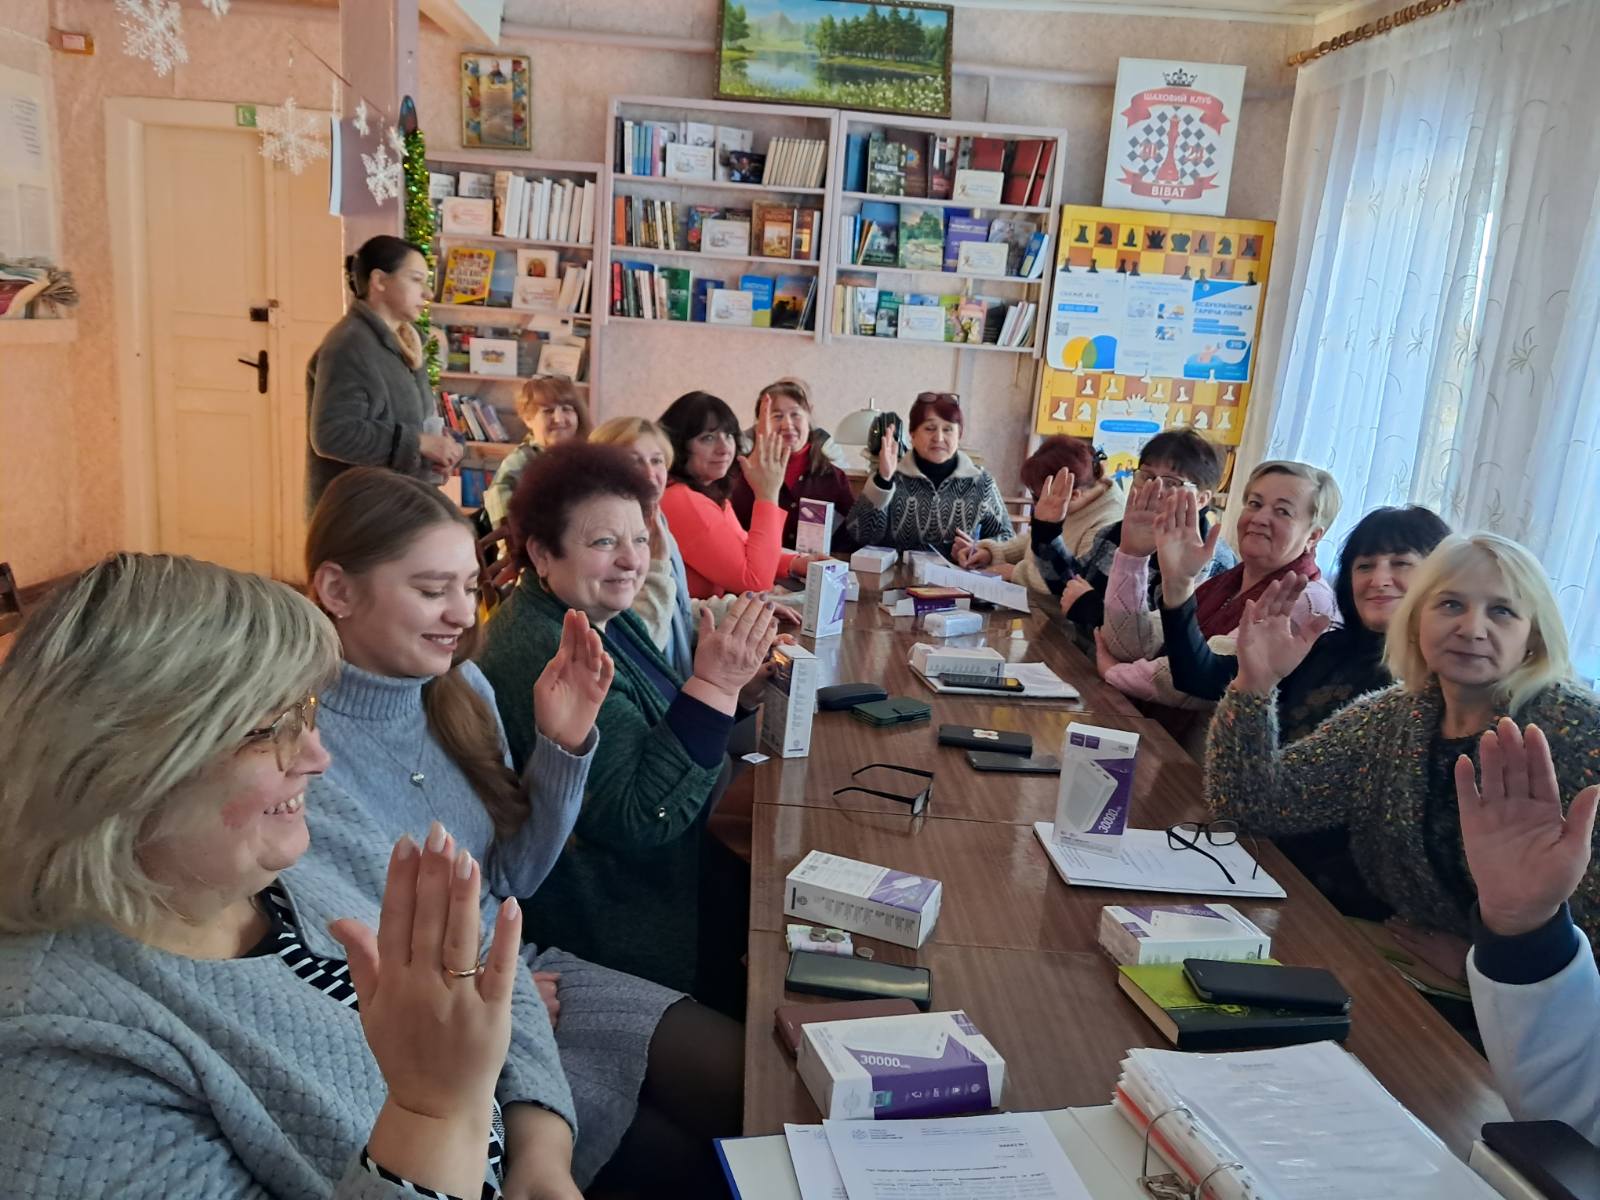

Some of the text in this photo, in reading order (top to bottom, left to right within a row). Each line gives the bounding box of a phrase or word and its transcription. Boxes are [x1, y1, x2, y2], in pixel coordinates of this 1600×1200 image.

[1143, 93, 1212, 105] ШАХОВИЙ КЛУБ
[1151, 186, 1187, 197] ВІВАТ
[1098, 808, 1119, 833] 30000
[859, 1054, 901, 1068] 30000
